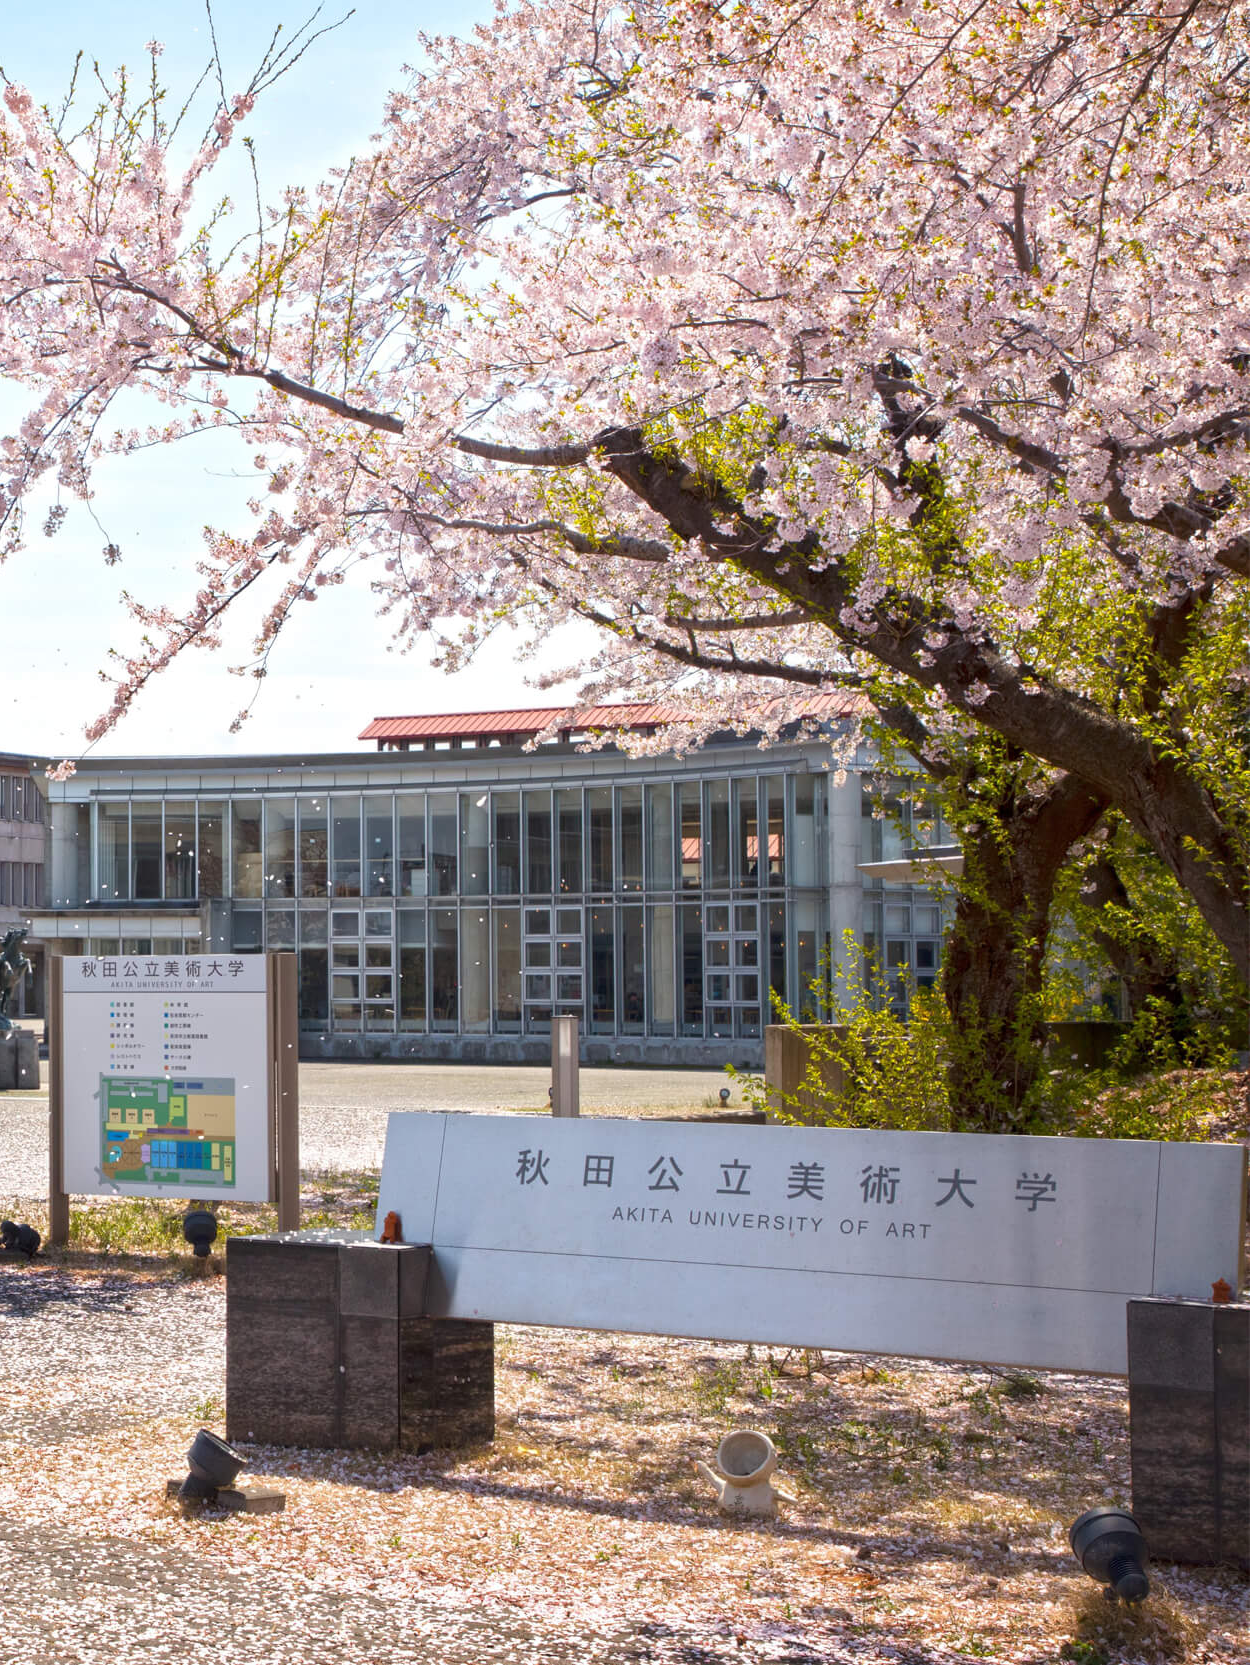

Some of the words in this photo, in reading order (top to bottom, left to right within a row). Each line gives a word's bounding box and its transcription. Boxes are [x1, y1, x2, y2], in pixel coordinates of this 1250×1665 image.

[82, 960, 244, 978] 秋田公立美術大学
[516, 1149, 1057, 1212] 秋田公立美術大学
[612, 1206, 673, 1223] AKITA
[689, 1211, 823, 1232] UNIVERSITY
[840, 1219, 869, 1235] OF
[886, 1223, 932, 1239] ART
